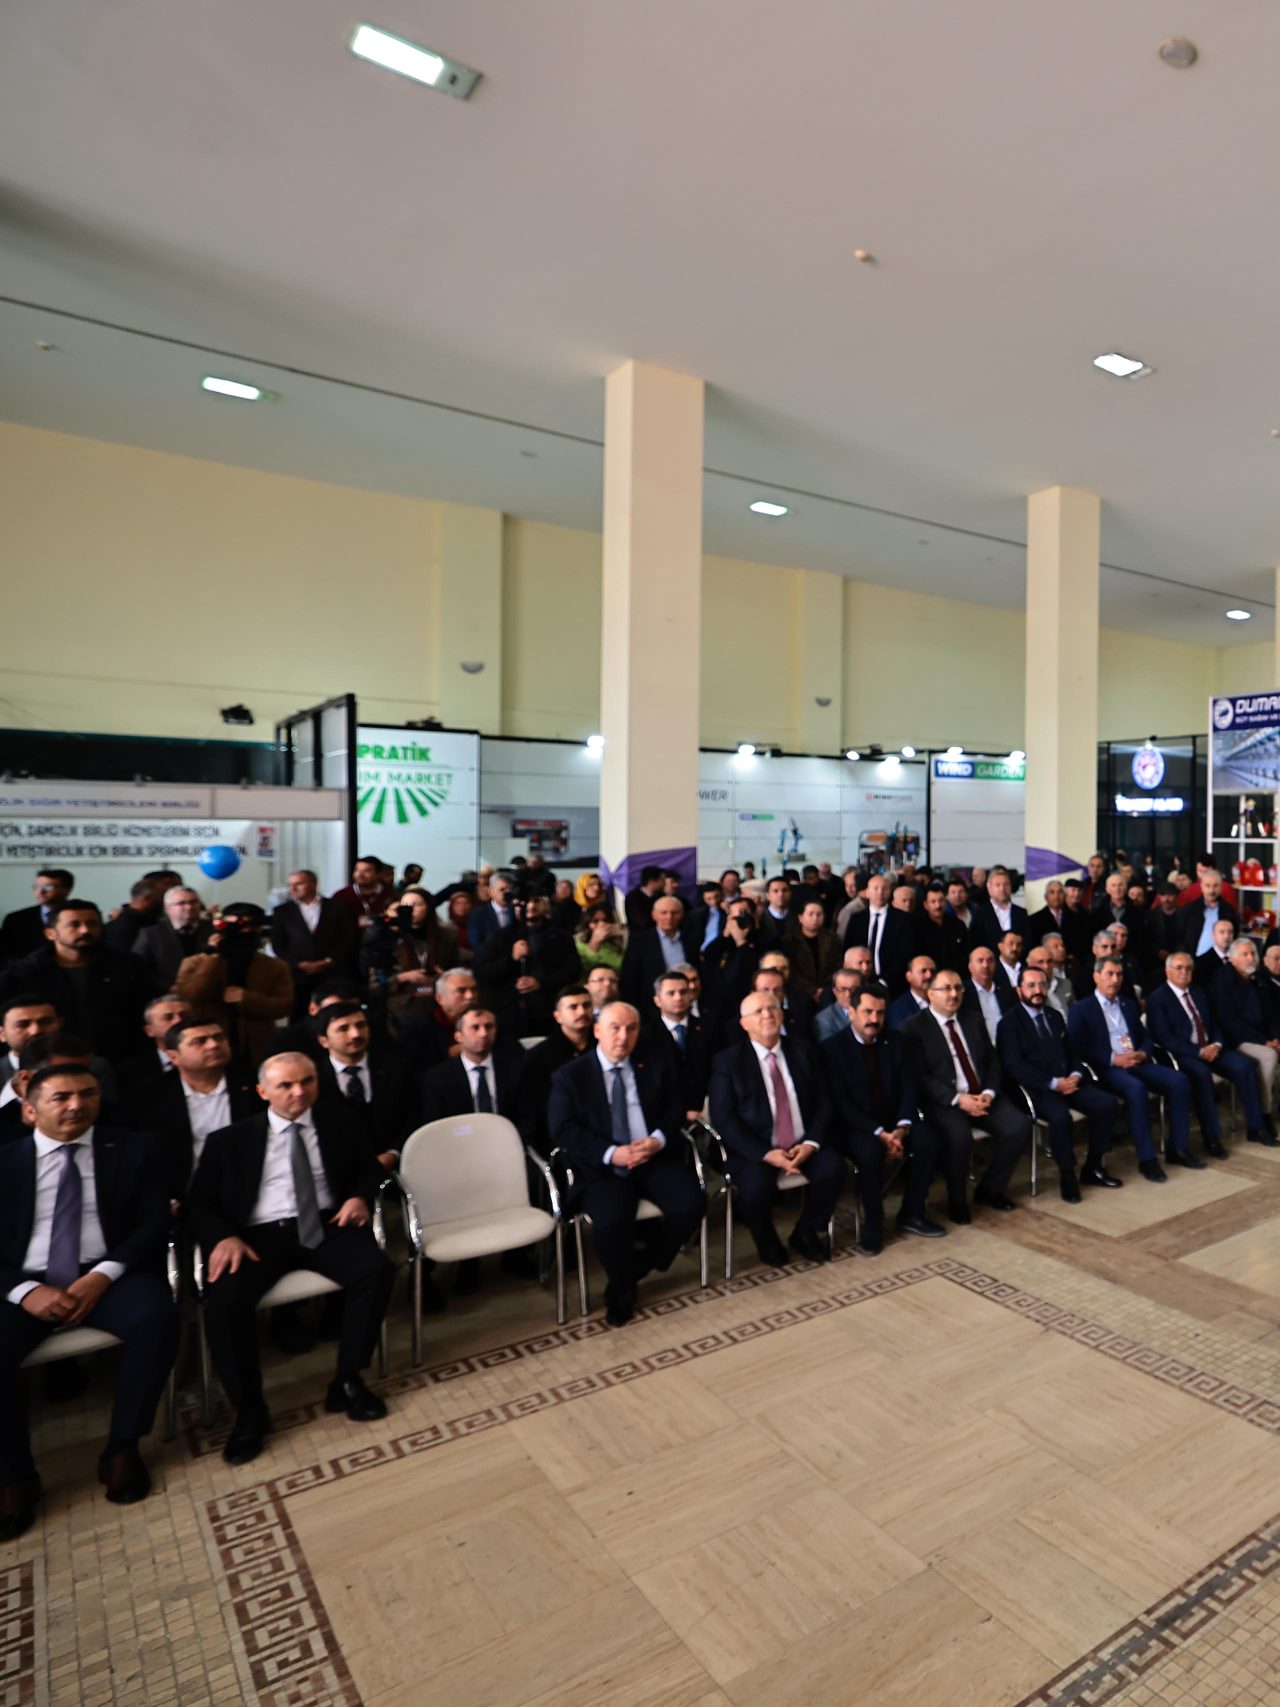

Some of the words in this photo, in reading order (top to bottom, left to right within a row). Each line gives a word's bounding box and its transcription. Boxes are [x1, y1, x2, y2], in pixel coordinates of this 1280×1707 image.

[357, 741, 431, 761] PRATİK
[388, 772, 453, 784] MARKET
[937, 762, 972, 776] WIND
[977, 763, 1024, 778] GARDEN
